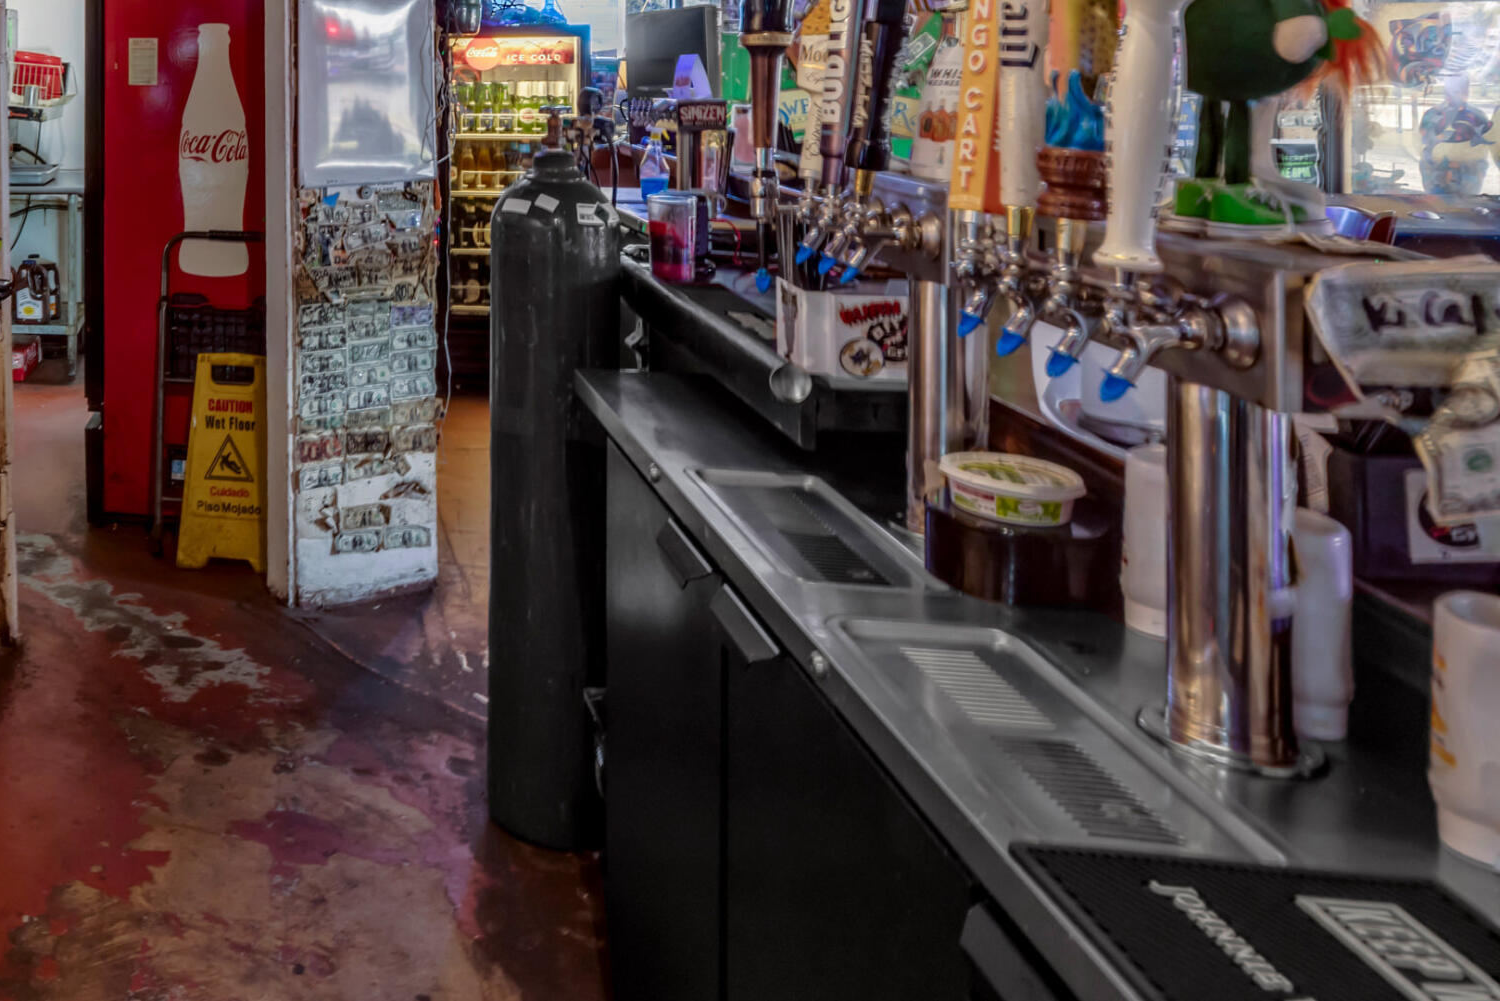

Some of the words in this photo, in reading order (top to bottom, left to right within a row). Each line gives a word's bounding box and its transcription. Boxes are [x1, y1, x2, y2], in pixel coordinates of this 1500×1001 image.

[999, 1, 1040, 69] Lite
[506, 53, 526, 62] ICE
[530, 53, 562, 62] COLD
[822, 54, 846, 123] BUD
[180, 128, 249, 164] Coca-Cola
[958, 87, 986, 190] CART
[208, 398, 253, 414] CAUTION
[205, 415, 227, 430] Wet
[229, 416, 257, 431] Floor
[209, 486, 251, 498] Cuidado
[196, 500, 221, 513] Piso
[221, 501, 263, 517] Mojado
[1147, 877, 1295, 993] JOHNNIE
